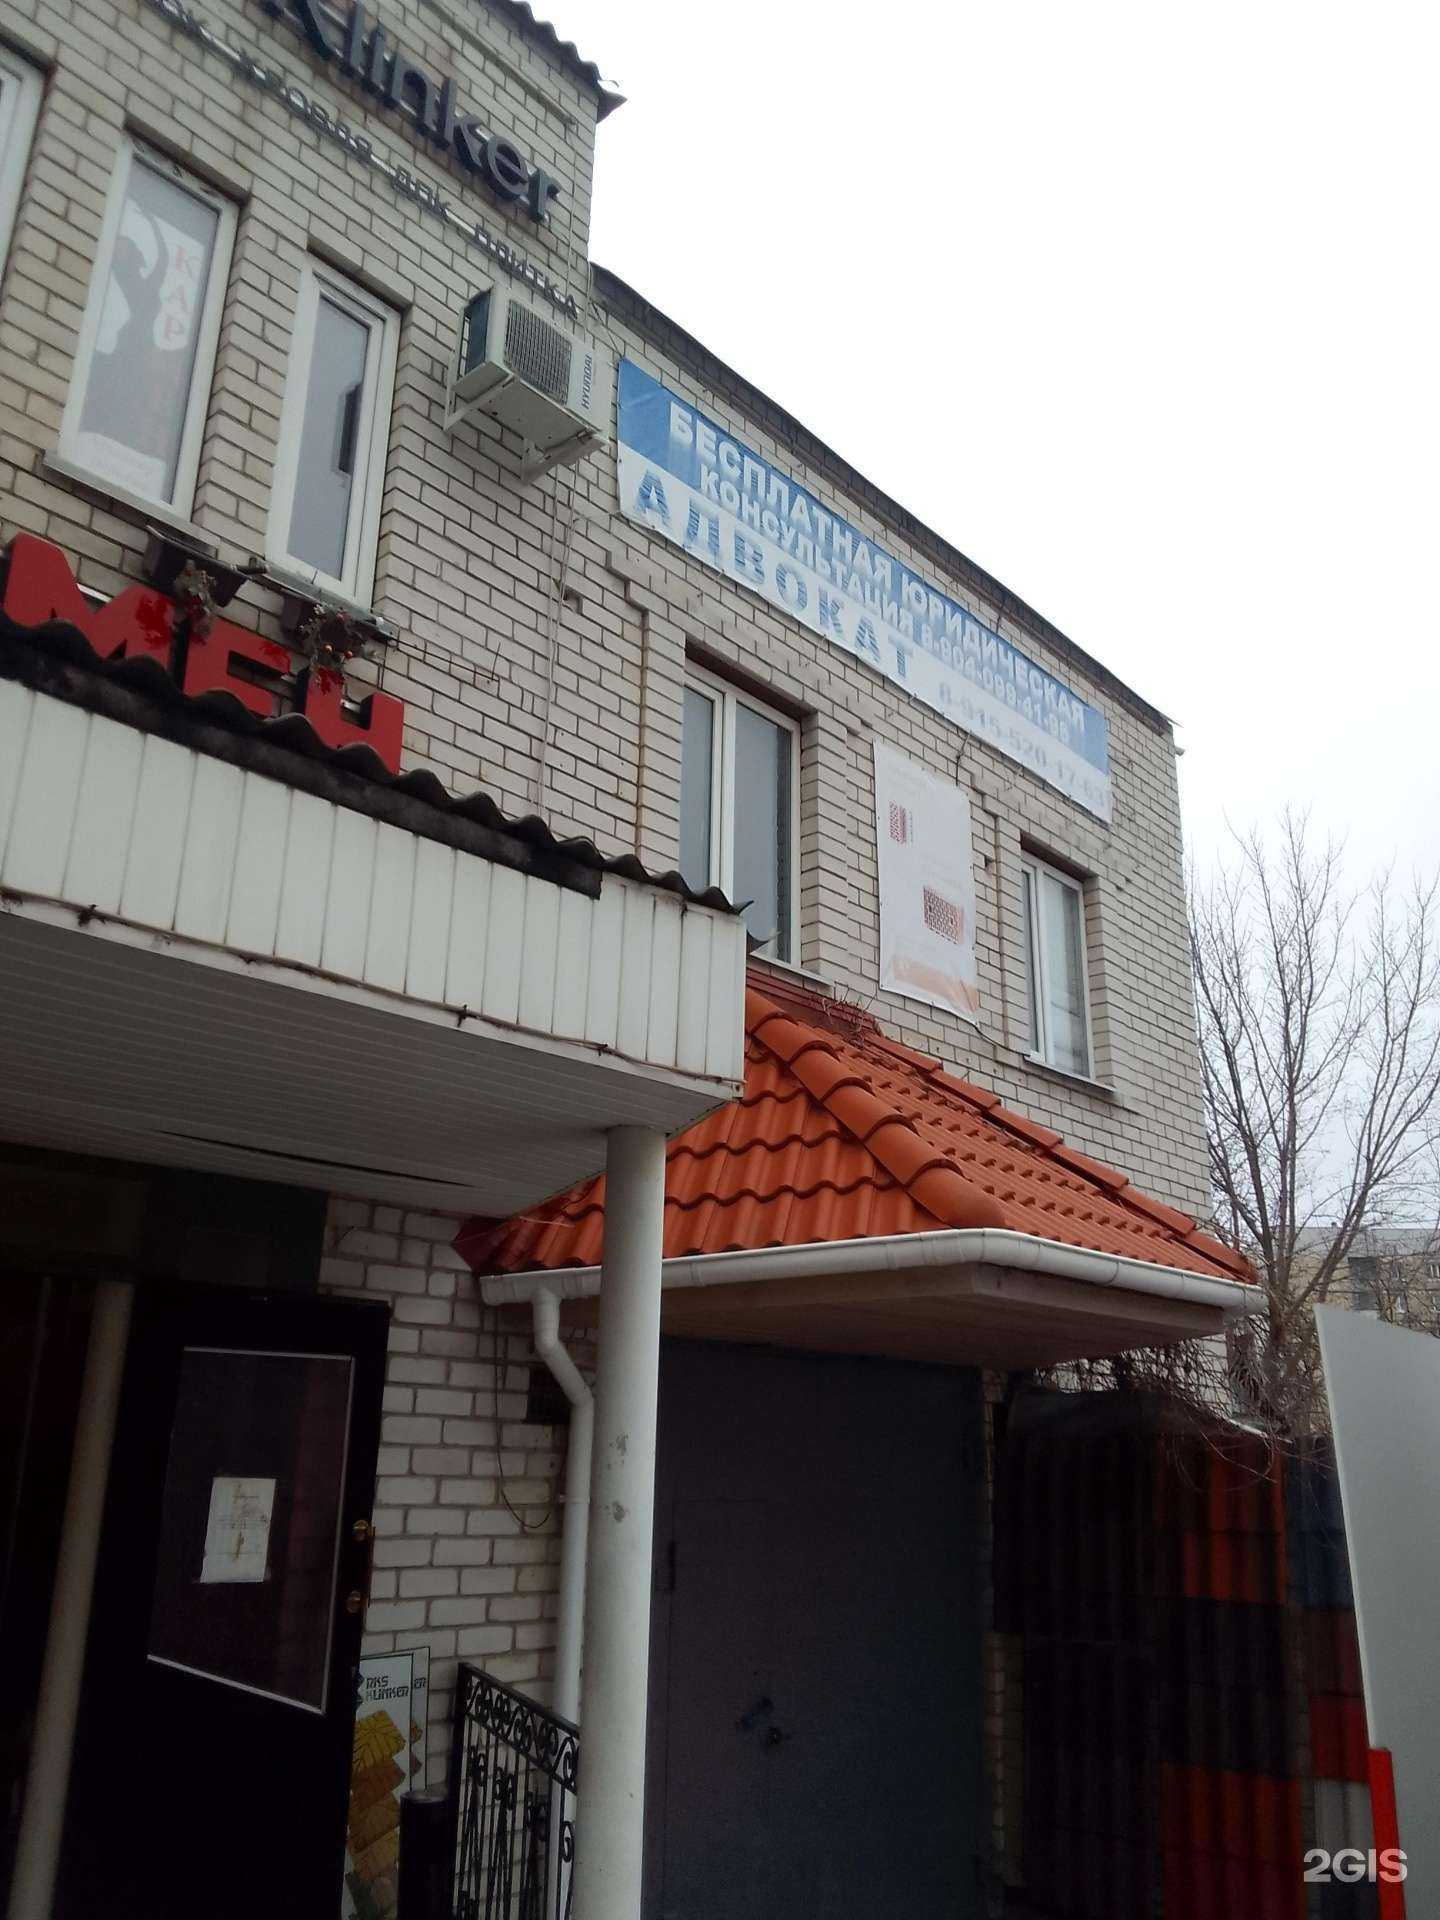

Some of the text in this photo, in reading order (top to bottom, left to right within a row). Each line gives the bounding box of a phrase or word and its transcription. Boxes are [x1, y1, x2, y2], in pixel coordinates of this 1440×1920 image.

[580, 352, 593, 411] HYUNDAI
[634, 470, 914, 680] АДВОКАТ
[669, 400, 1086, 736] БЕСПЛАТНАЯ ЮРИДИЧЕСКАЯ
[700, 463, 914, 637] КОНСУЛЬТАЦИЯ
